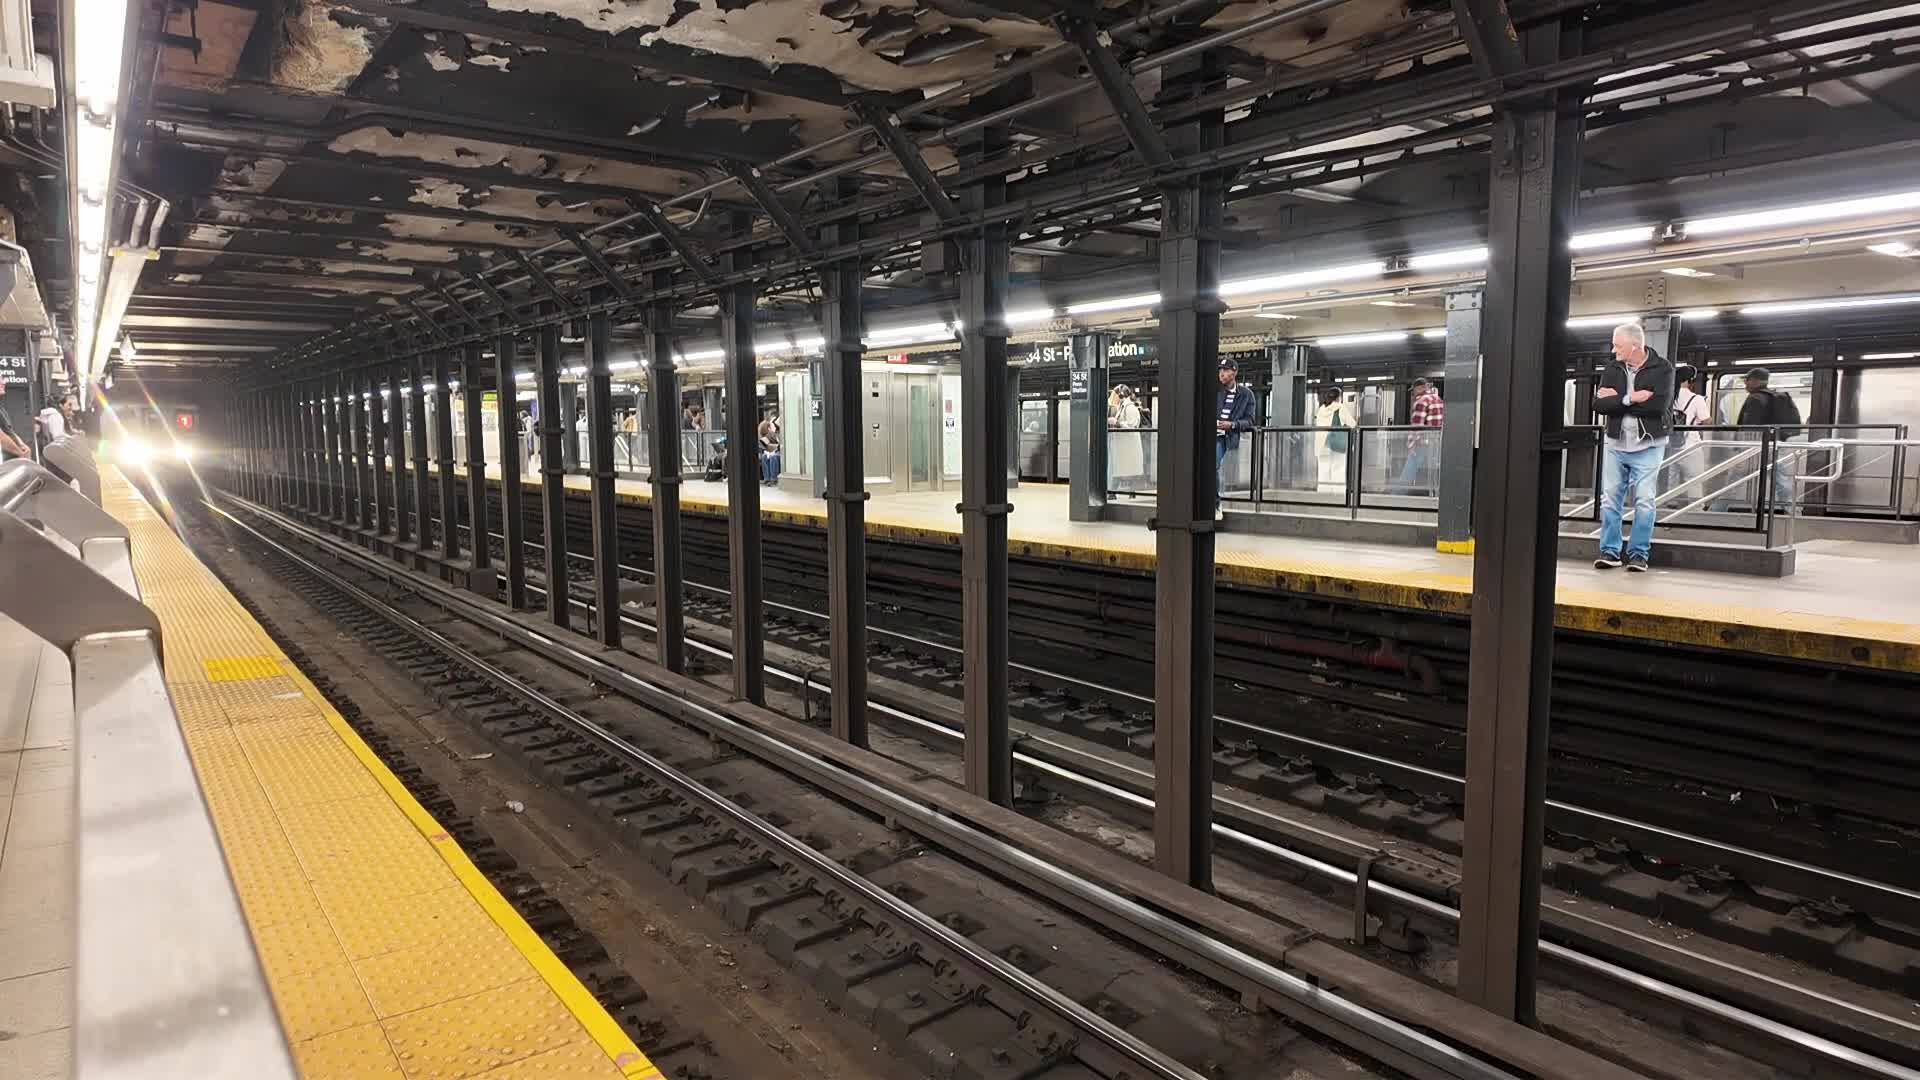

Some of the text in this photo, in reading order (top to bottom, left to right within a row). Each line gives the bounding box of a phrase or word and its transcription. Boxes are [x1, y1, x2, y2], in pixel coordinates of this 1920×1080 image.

[1026, 347, 1041, 363] 34
[1043, 345, 1072, 361] St-P
[1108, 341, 1138, 357] ation
[0, 358, 26, 367] 4 St
